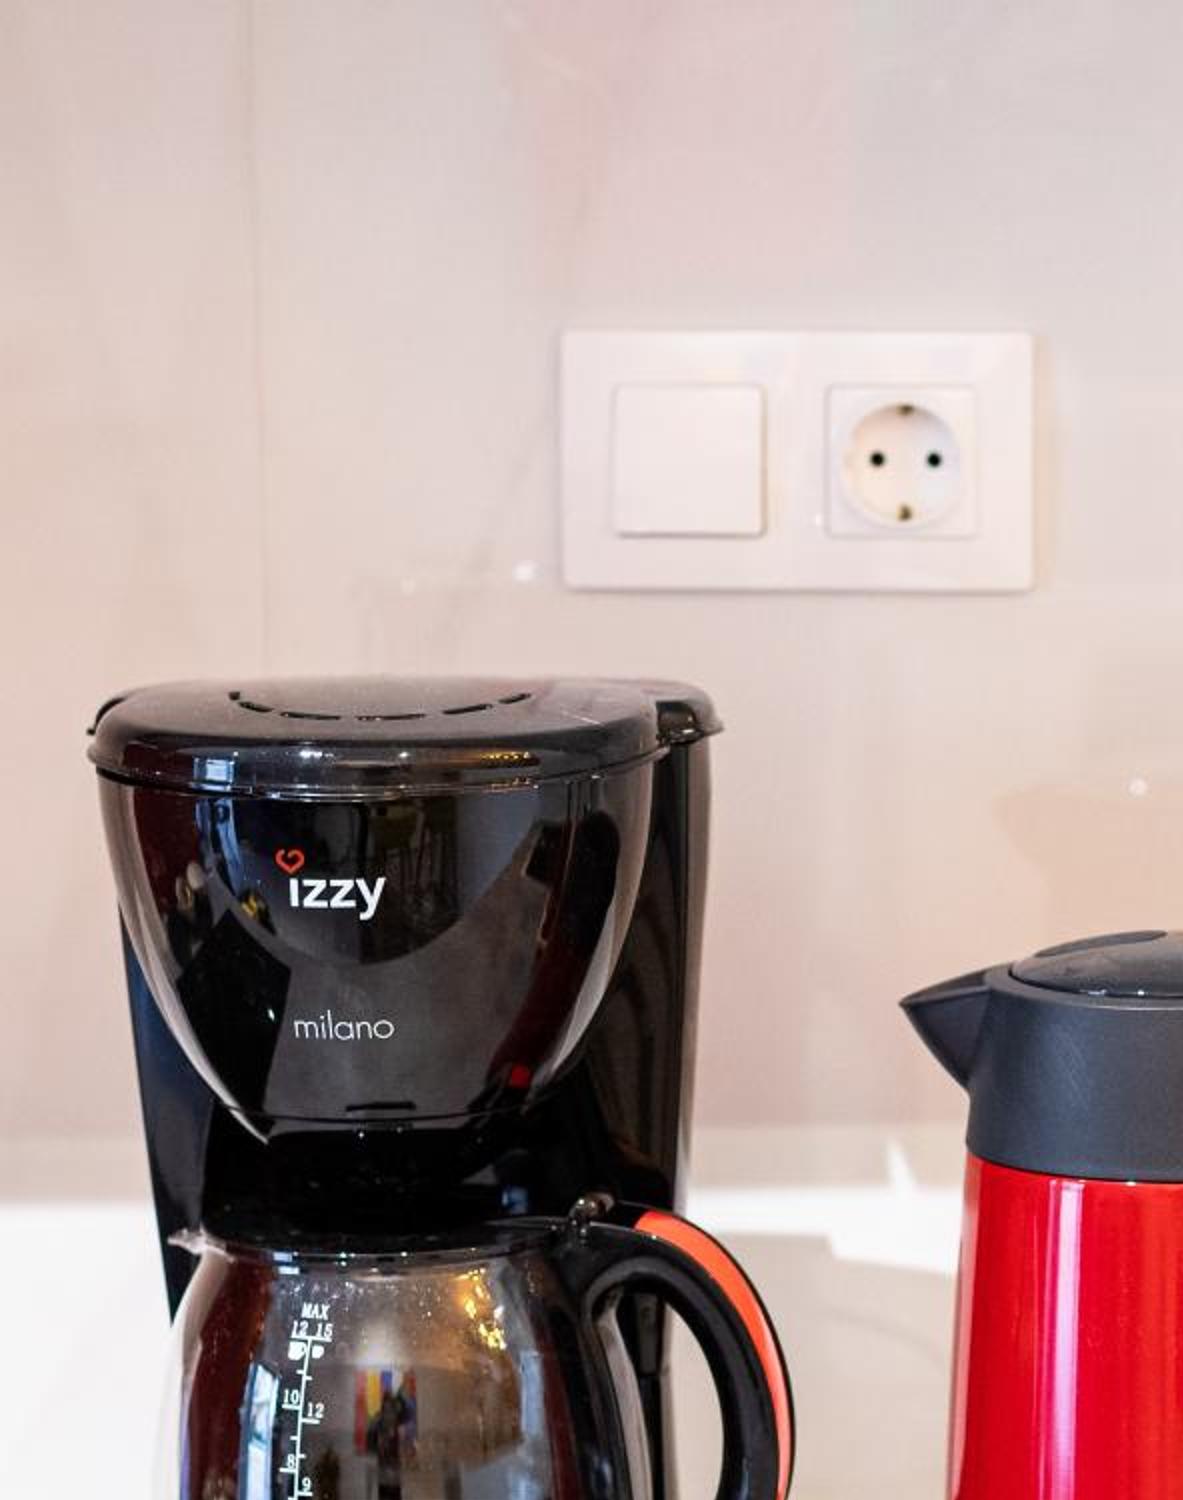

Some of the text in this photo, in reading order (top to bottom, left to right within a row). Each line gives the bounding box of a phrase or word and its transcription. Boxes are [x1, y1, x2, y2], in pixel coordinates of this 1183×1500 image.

[289, 876, 386, 921] izzy
[293, 1009, 395, 1040] milano
[301, 1302, 331, 1320] MAX
[291, 1320, 333, 1339] 12 15
[283, 1389, 299, 1405] 10
[308, 1402, 325, 1418] 12
[287, 1453, 295, 1469] 8
[302, 1477, 312, 1492] 9
